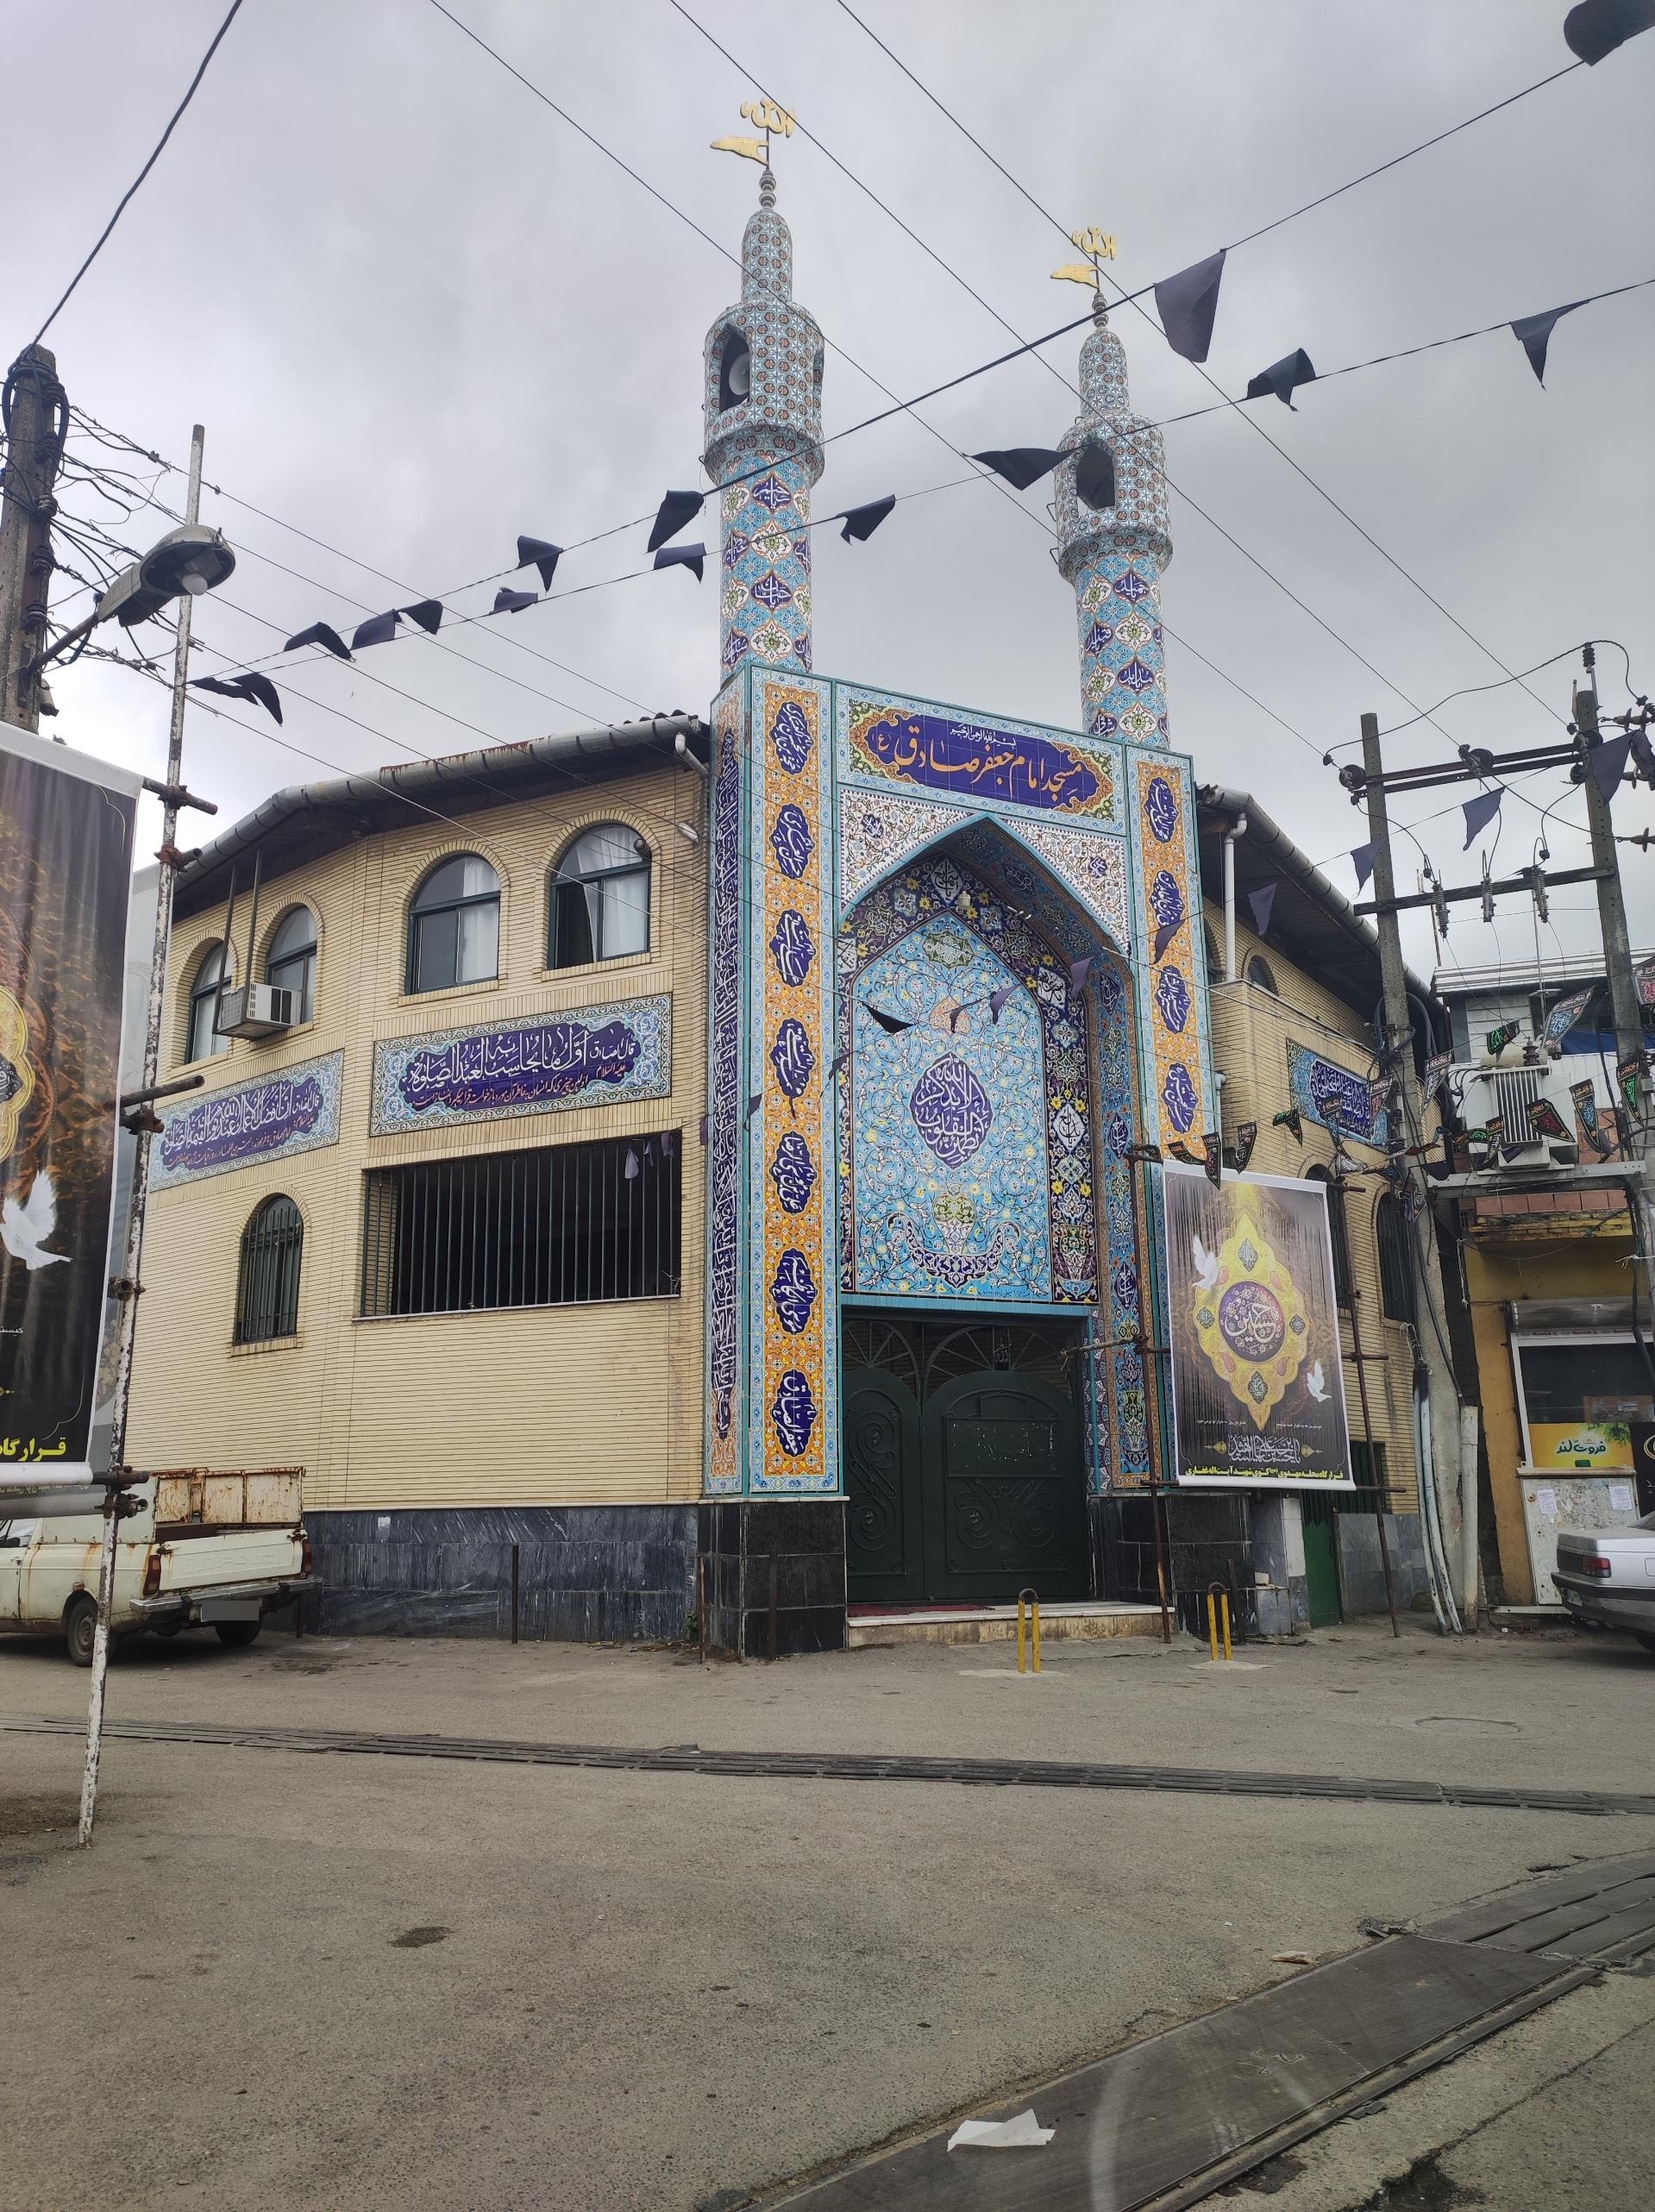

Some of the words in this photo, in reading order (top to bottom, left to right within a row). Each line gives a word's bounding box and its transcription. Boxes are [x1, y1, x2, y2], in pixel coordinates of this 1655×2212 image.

[893, 725, 980, 774] صادق
[970, 744, 1012, 786] جعفر
[1007, 755, 1046, 800] امام
[1040, 762, 1082, 802] مسجد
